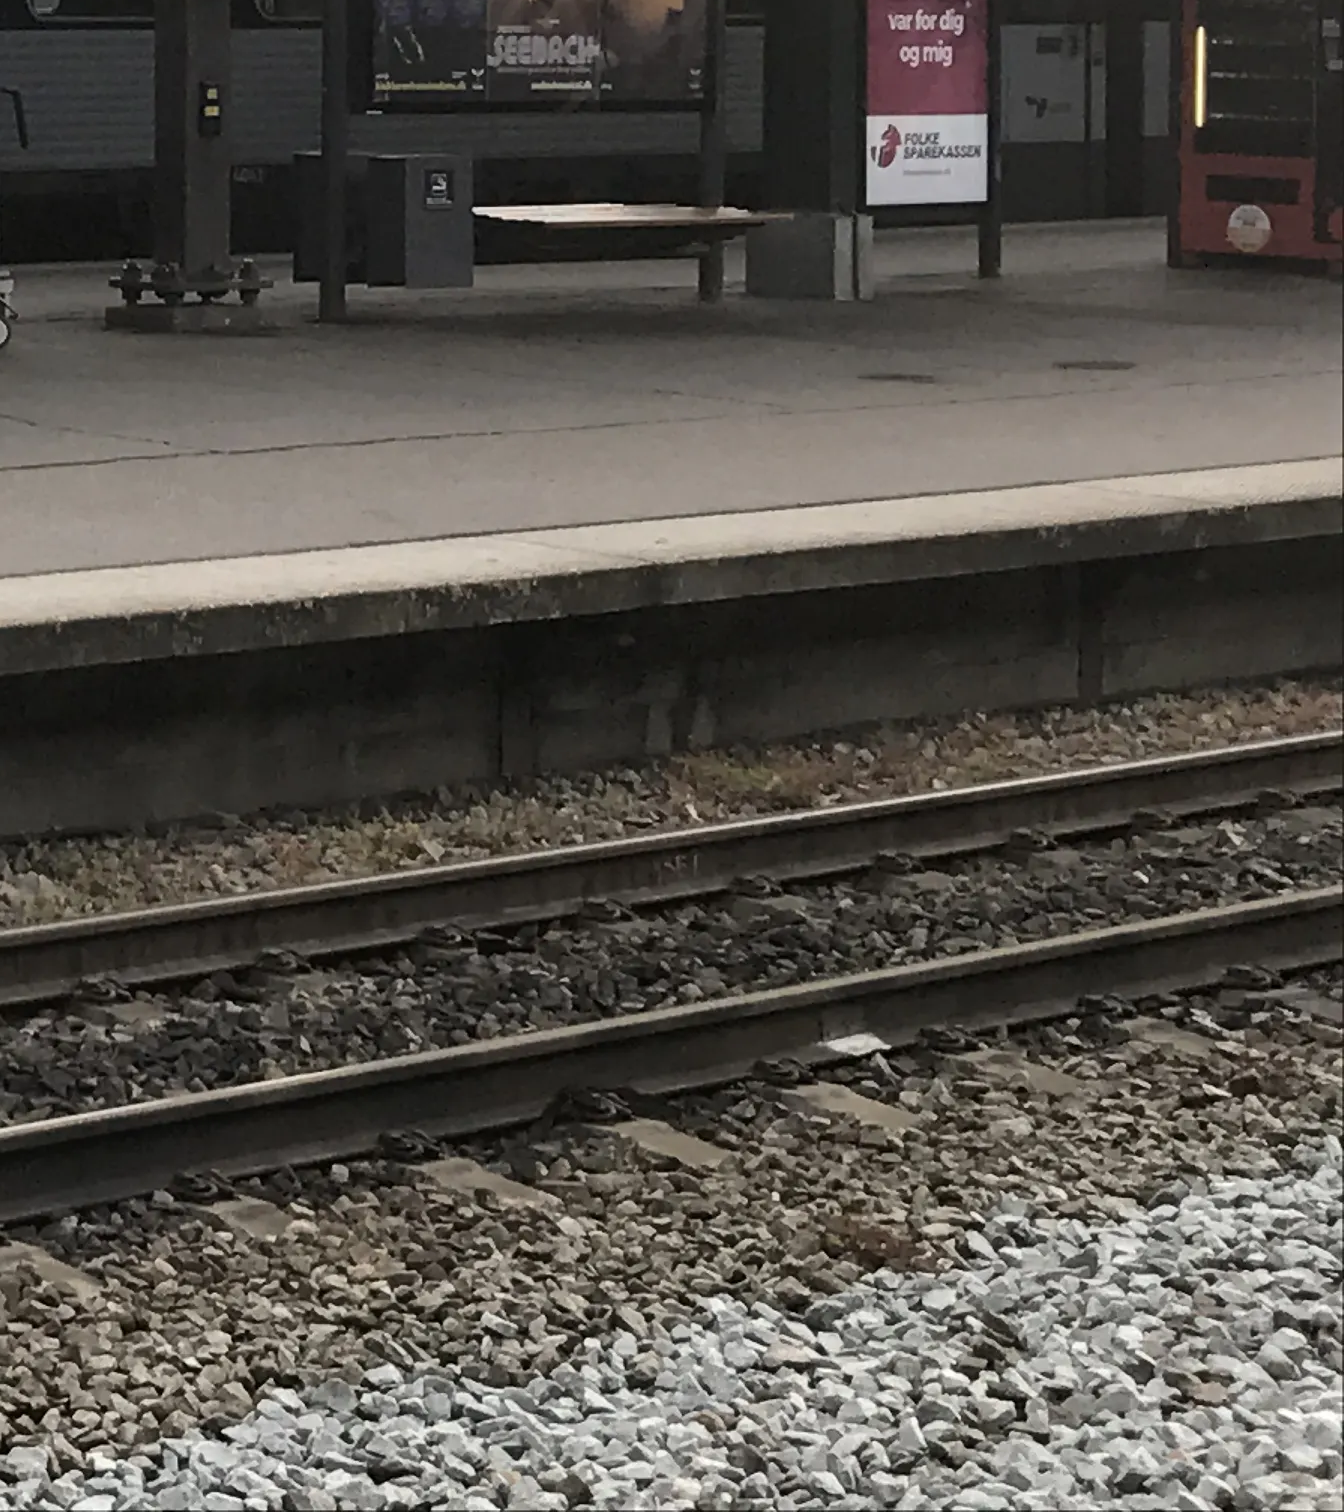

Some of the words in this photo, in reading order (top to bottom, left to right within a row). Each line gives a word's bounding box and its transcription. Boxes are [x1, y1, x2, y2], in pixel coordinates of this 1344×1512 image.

[888, 12, 912, 31] var
[914, 9, 937, 31] for
[938, 9, 964, 36] dig
[899, 45, 920, 68] og
[922, 40, 953, 68] mig
[904, 131, 940, 145] FOLKE
[903, 145, 982, 161] SPAREKASSEN
